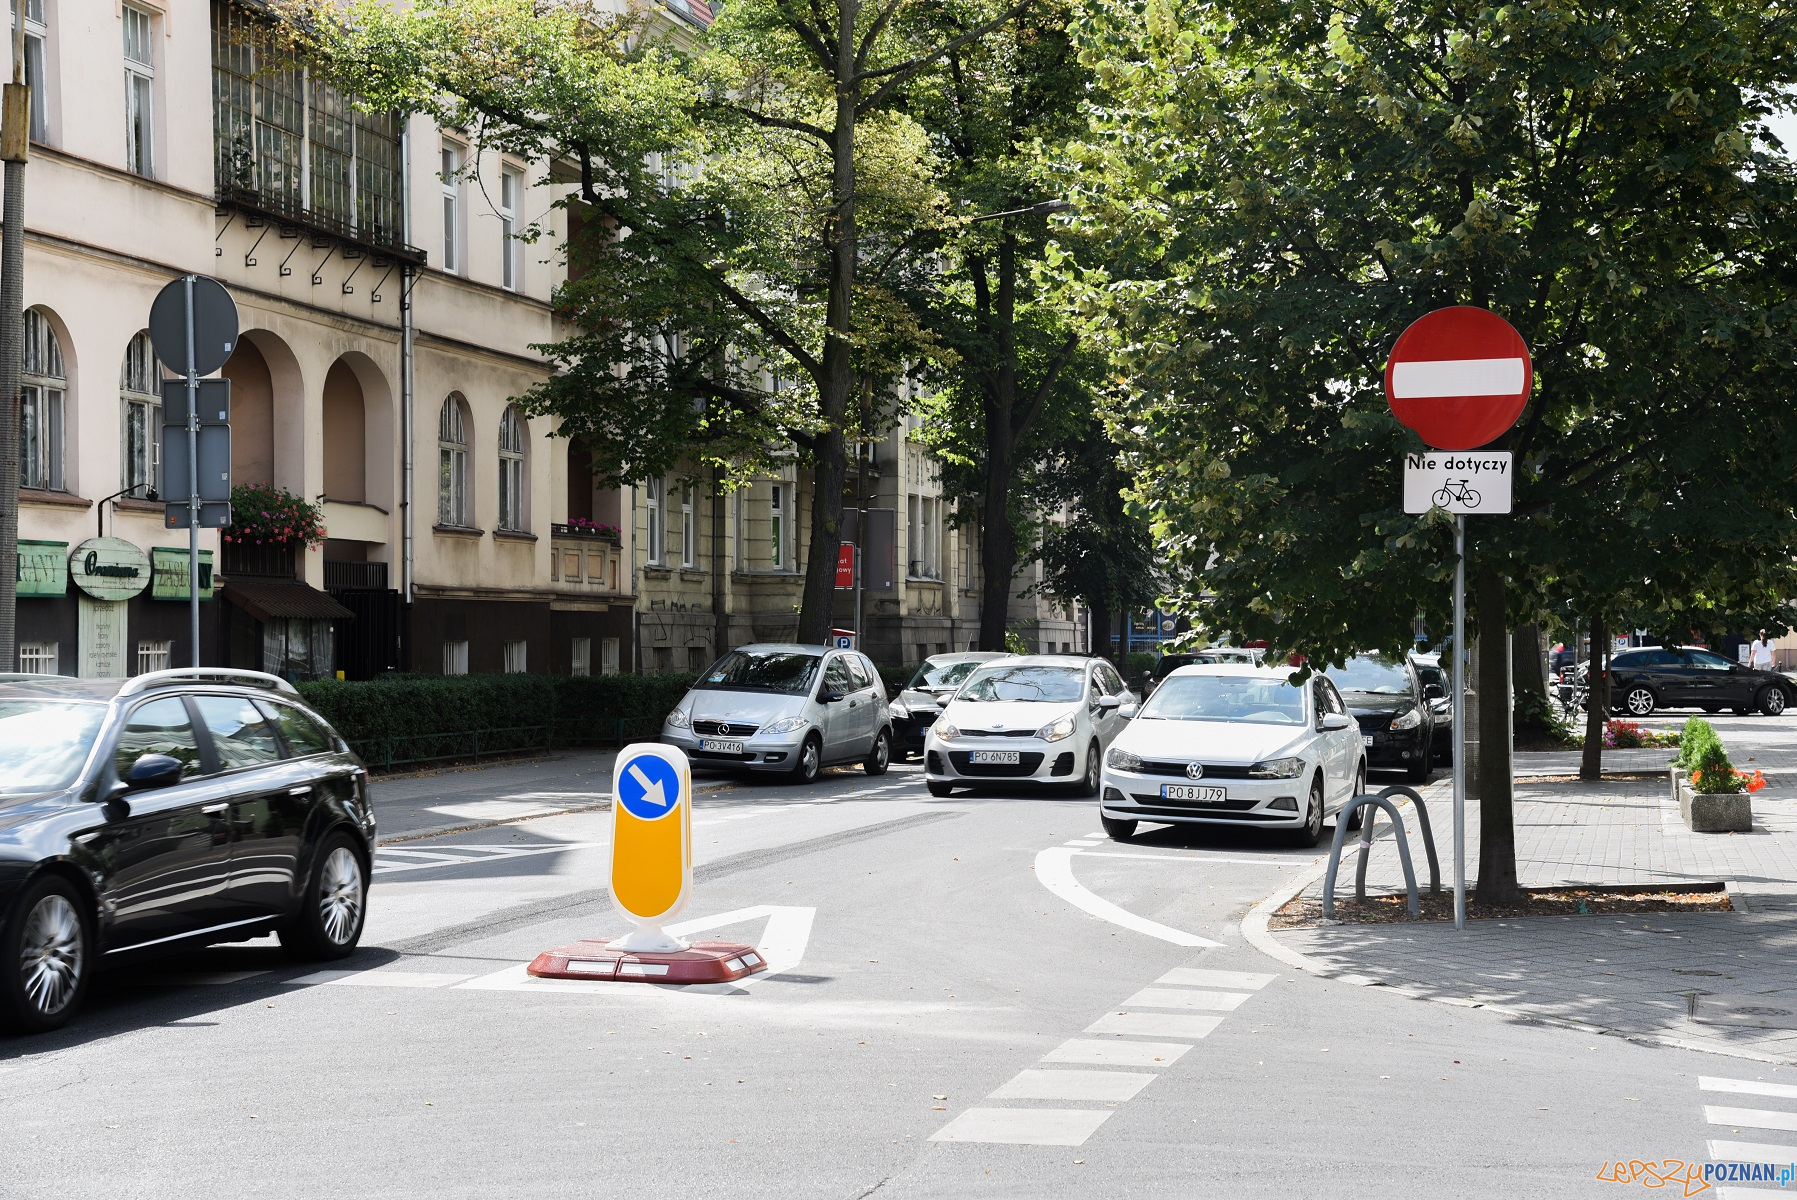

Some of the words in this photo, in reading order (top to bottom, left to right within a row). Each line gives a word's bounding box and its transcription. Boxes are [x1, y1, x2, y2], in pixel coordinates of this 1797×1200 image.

[1408, 456, 1436, 471] Nie
[1444, 456, 1508, 474] dotyczy
[19, 553, 59, 583] RANY
[704, 741, 715, 749] PO
[717, 742, 741, 752] 3V416
[974, 752, 988, 761] PO
[990, 752, 1018, 761] 6N785
[1168, 786, 1184, 798] PO
